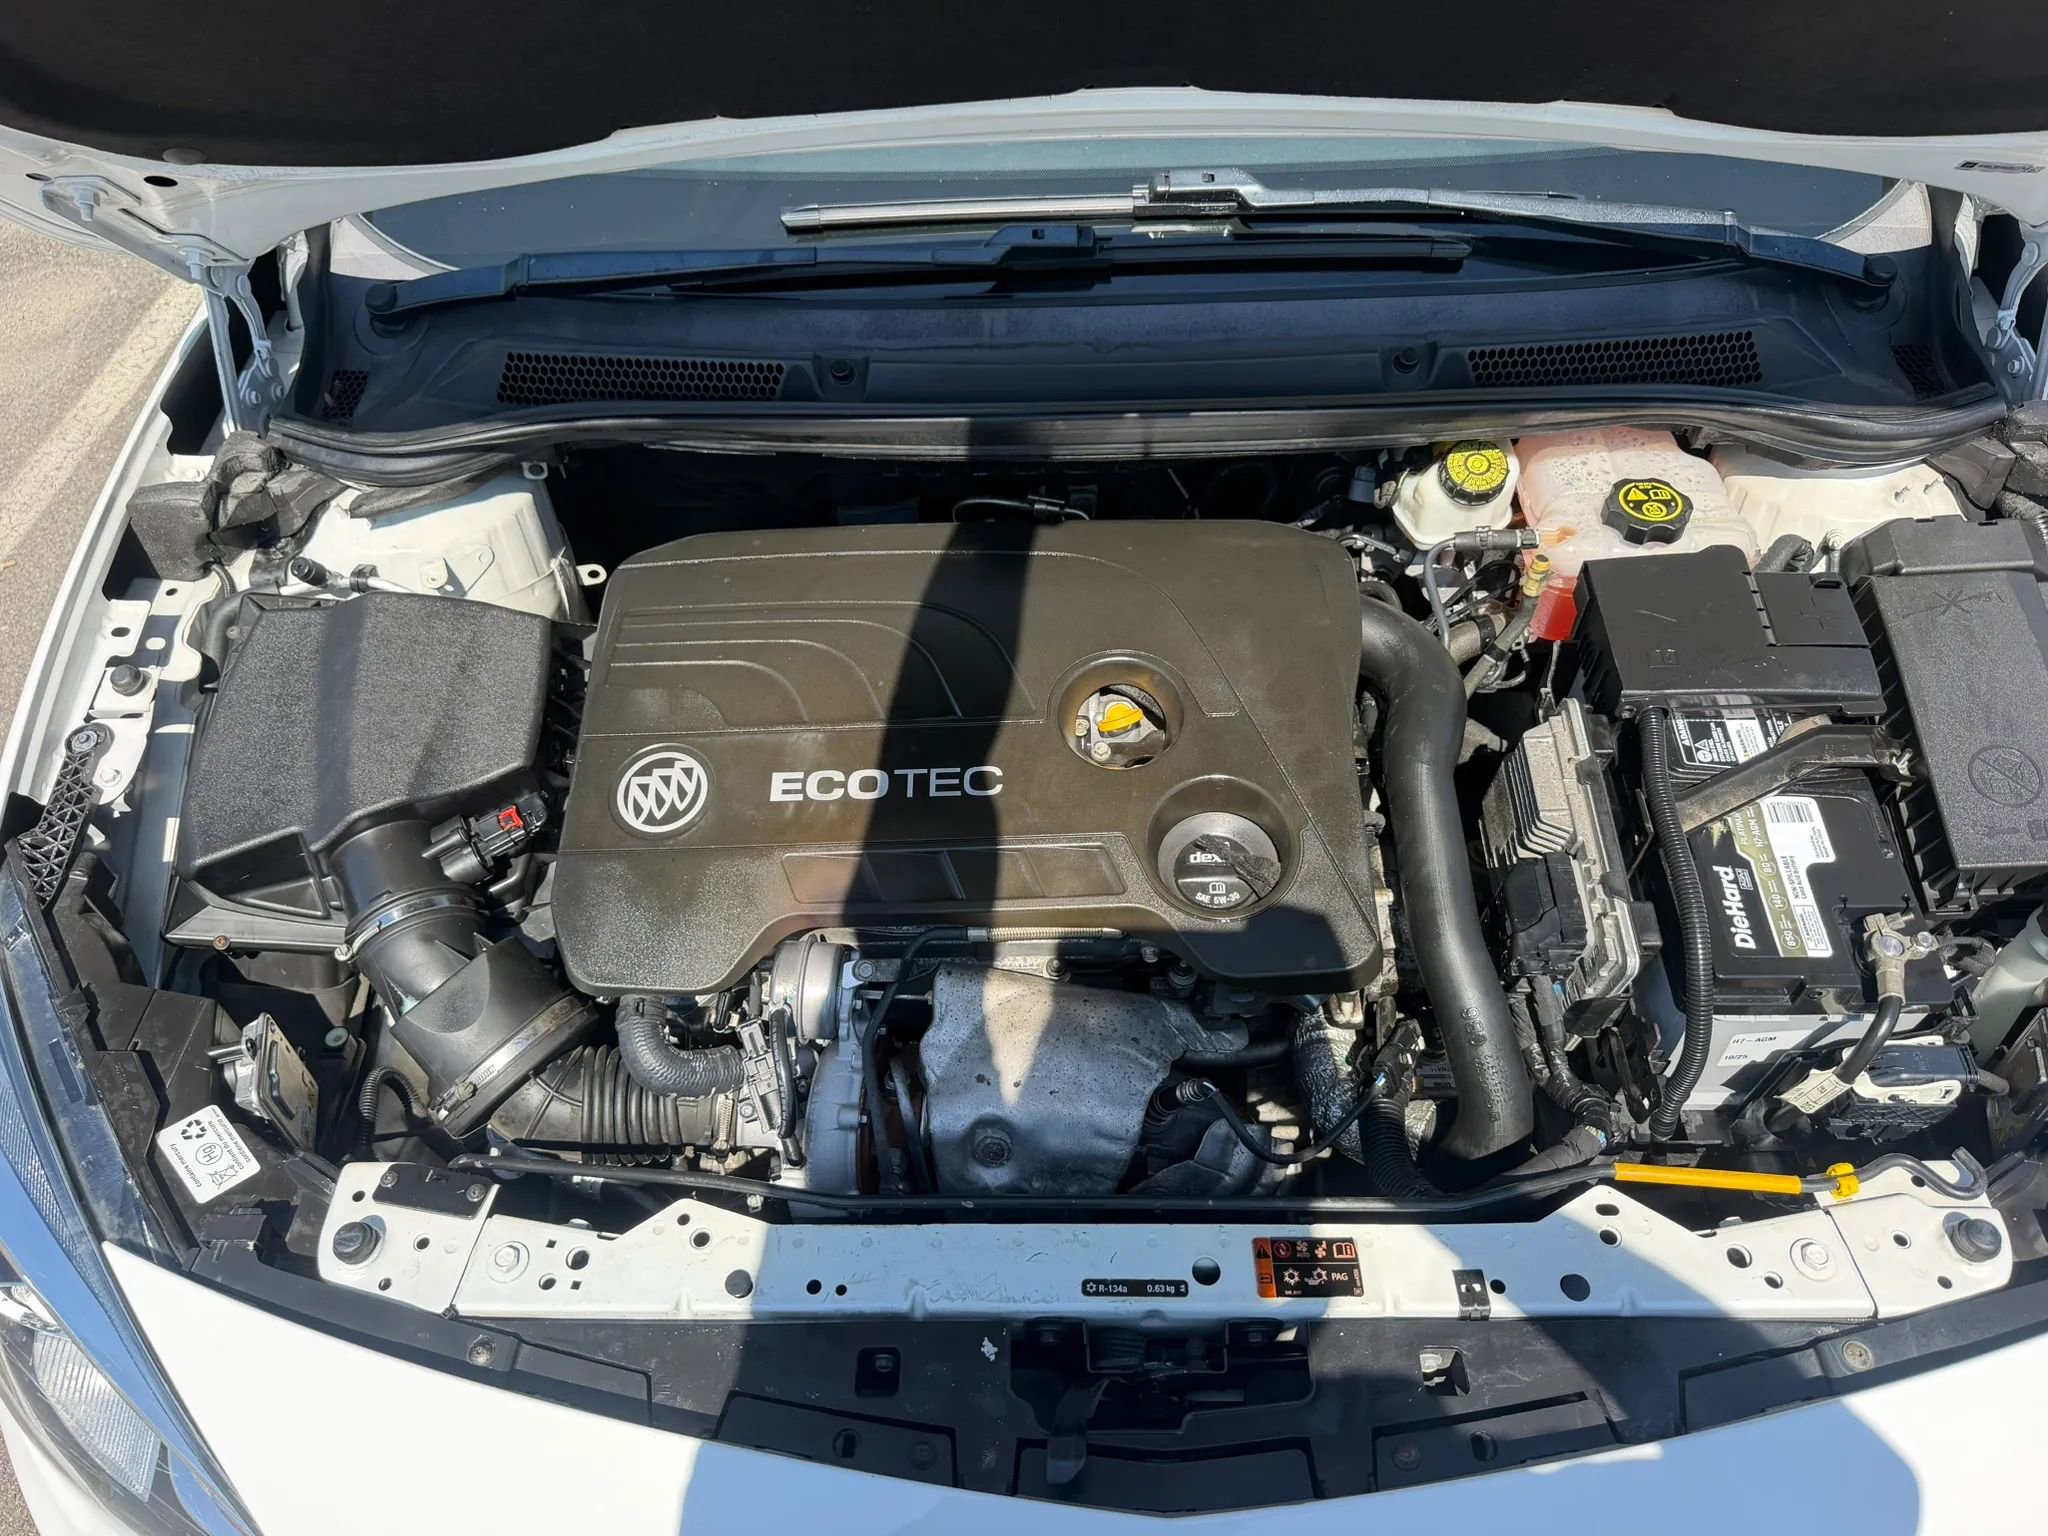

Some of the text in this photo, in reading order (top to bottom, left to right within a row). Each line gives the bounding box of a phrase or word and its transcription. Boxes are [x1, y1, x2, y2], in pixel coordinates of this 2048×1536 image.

[769, 765, 1004, 802] ECOTEC
[1733, 812, 1749, 846] PLATINU
[1195, 892, 1240, 904] SAE 5W-30
[1712, 865, 1757, 950] DieHard
[169, 1143, 187, 1166] mercury
[202, 1144, 218, 1163] Hg
[1331, 1272, 1349, 1281] PAG
[1099, 1284, 1128, 1293] R-134a
[1147, 1284, 1165, 1293] 0.63
[1166, 1284, 1175, 1294] kg
